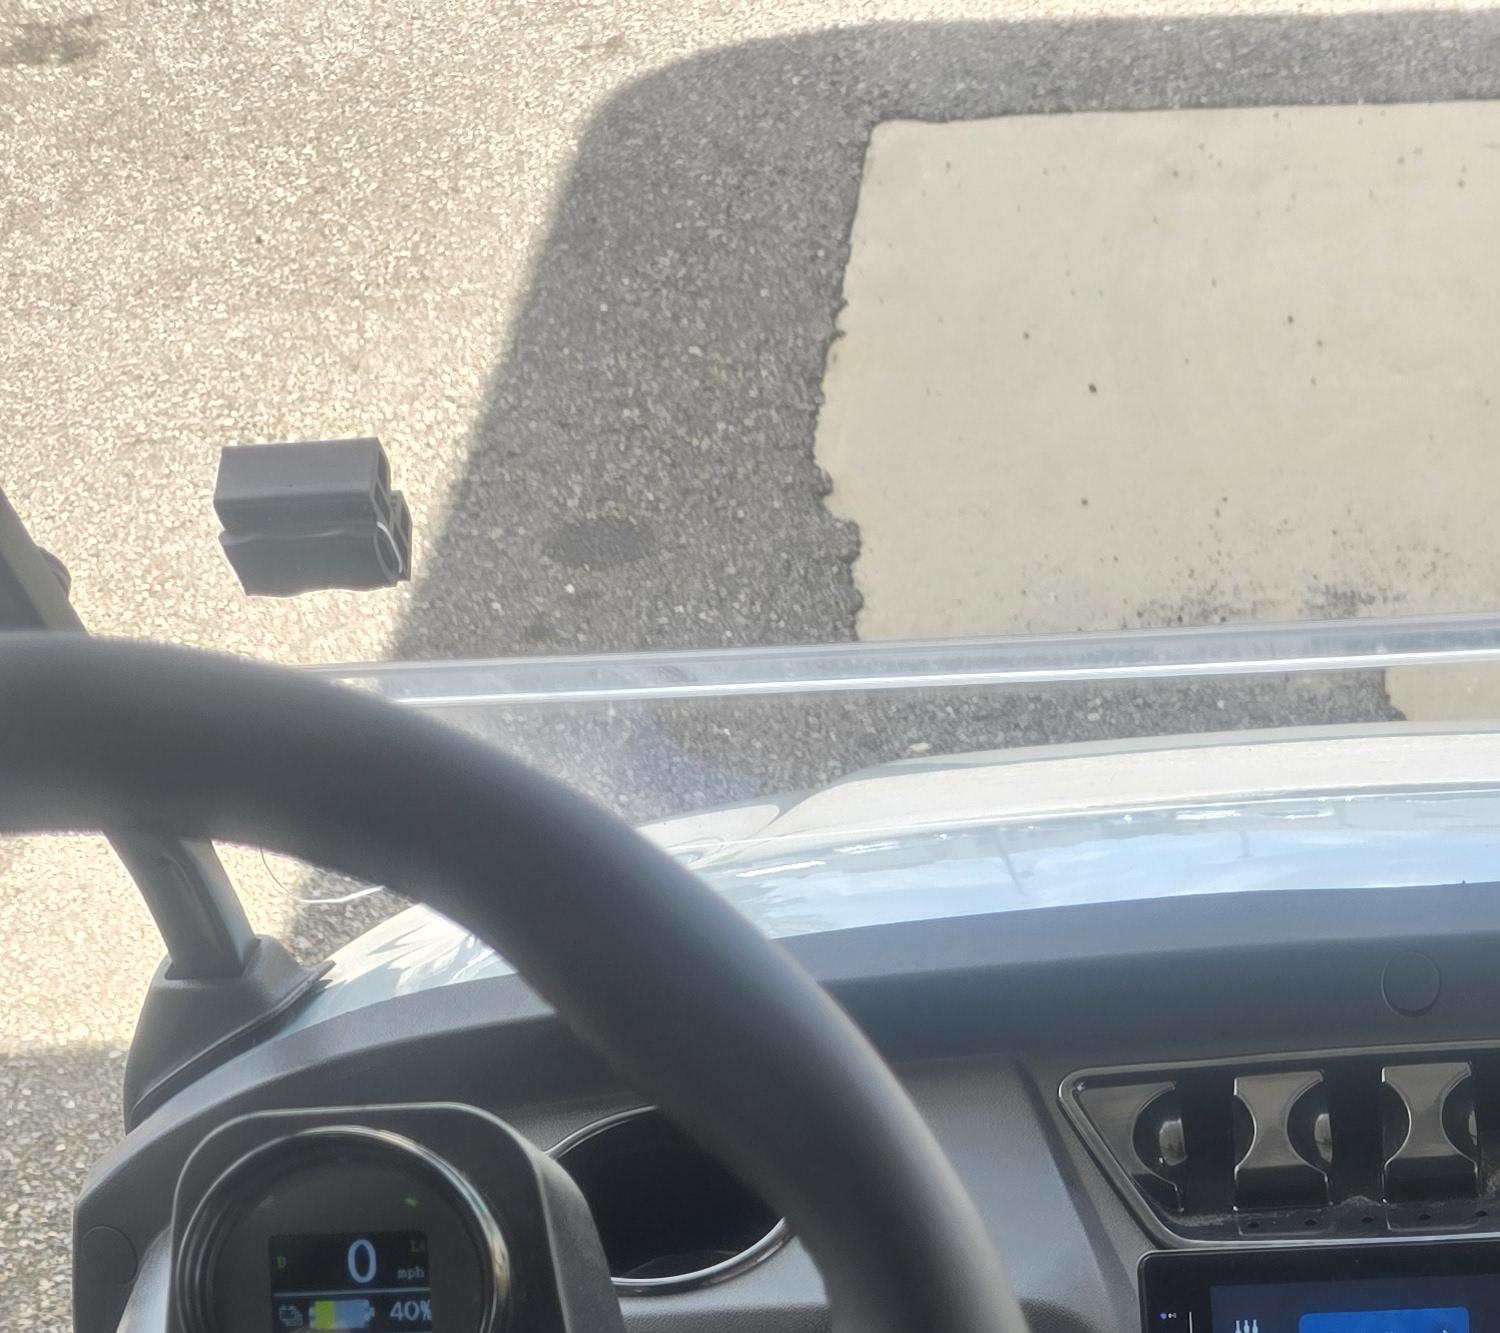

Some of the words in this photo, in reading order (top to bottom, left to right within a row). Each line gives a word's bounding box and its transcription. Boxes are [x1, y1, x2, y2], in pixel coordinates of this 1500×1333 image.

[347, 1238, 377, 1284] 0
[397, 1266, 425, 1281] mph
[389, 1300, 432, 1321] 40%
